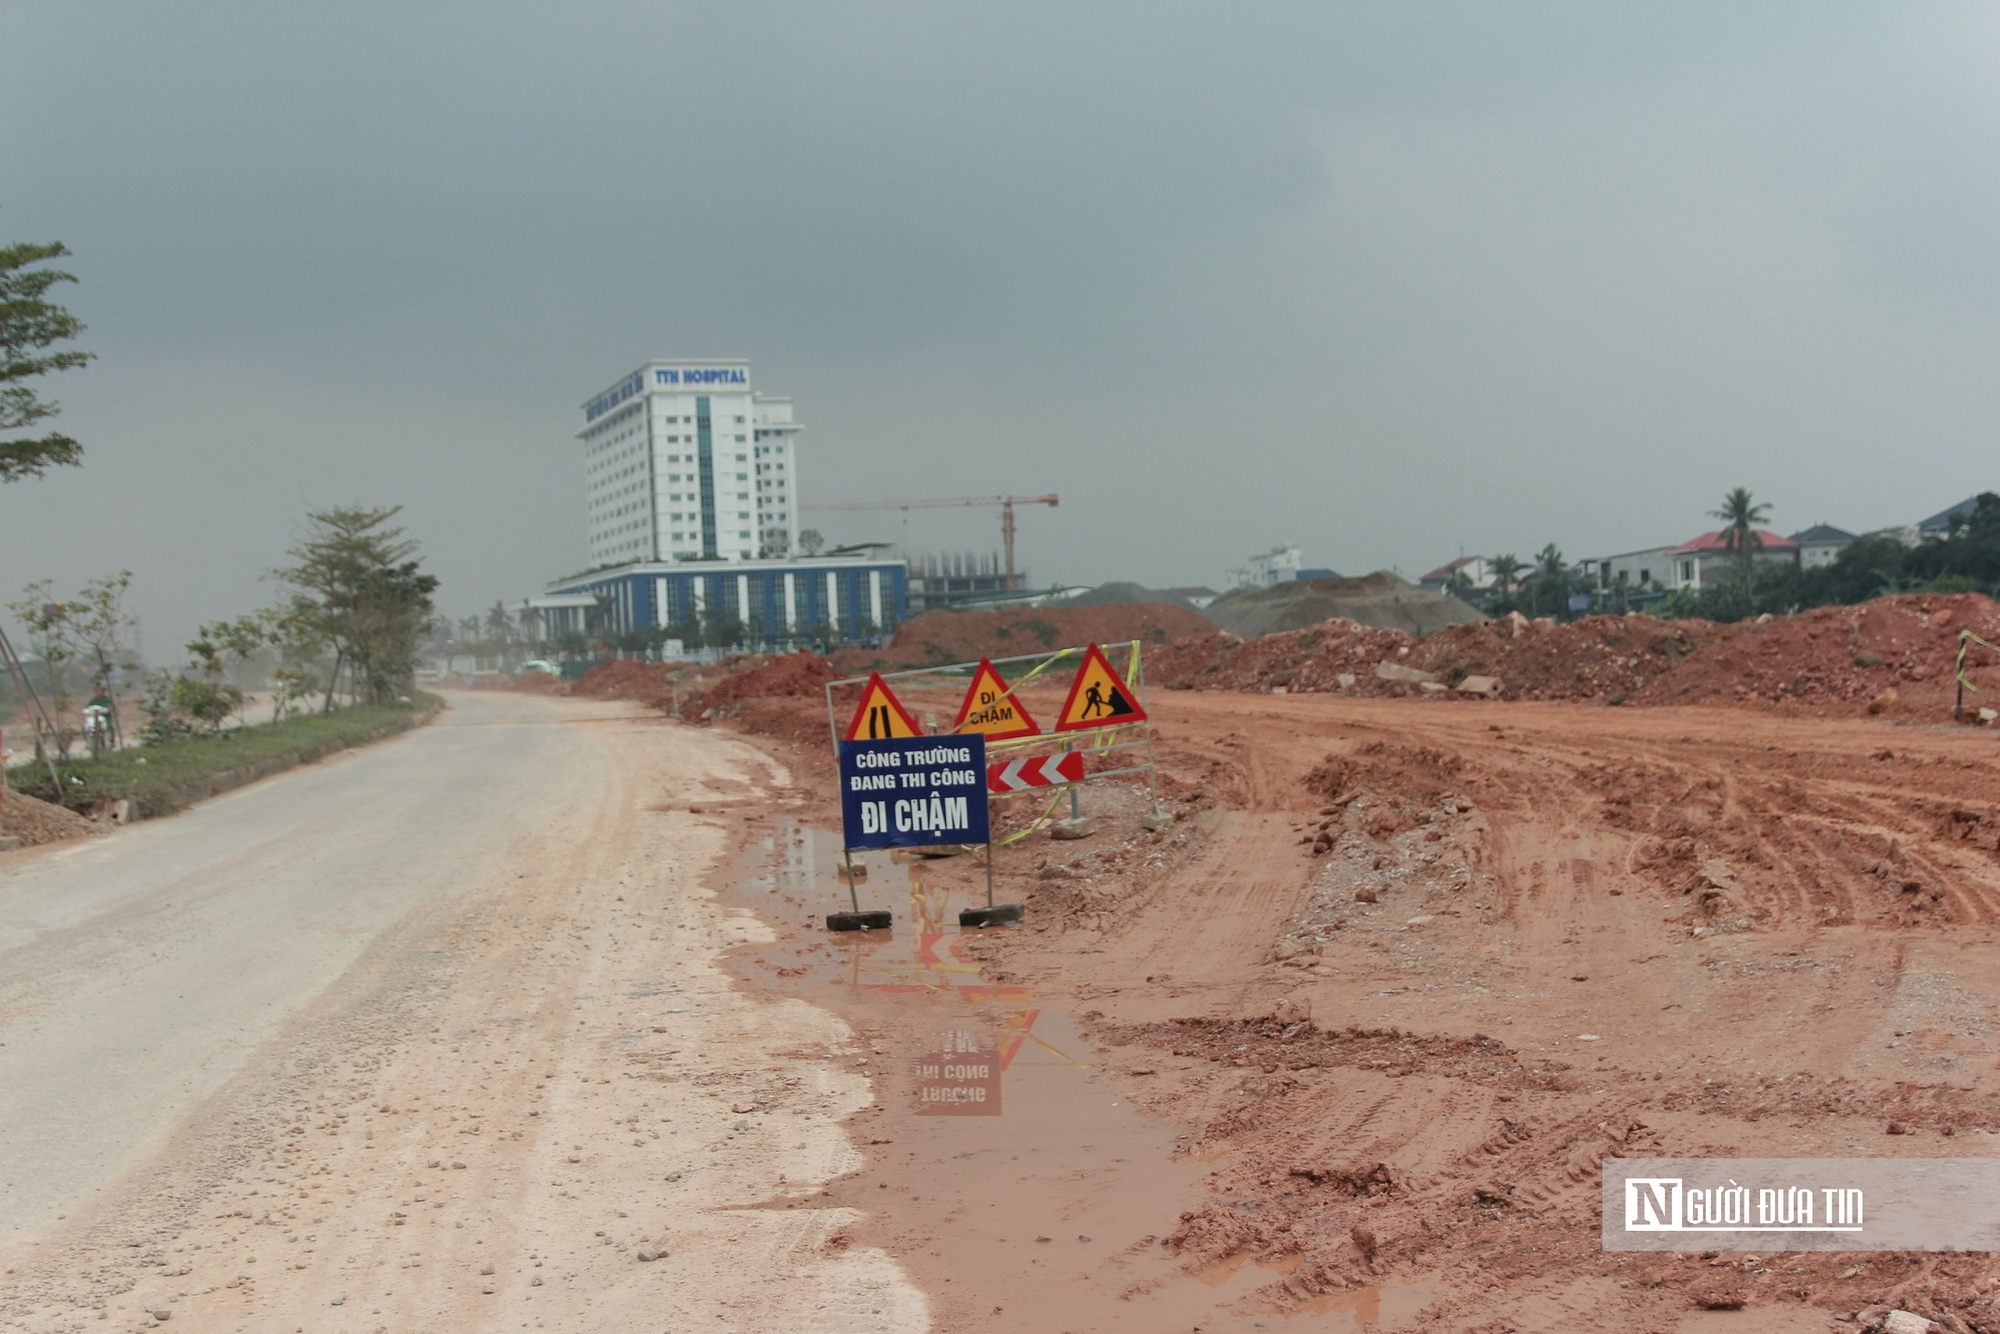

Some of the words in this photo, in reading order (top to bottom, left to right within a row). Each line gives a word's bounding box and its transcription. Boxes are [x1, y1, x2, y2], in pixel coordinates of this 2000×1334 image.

[655, 370, 679, 384] TTH
[683, 370, 747, 384] HOSPITAL
[981, 691, 995, 704] ĐI
[856, 750, 901, 768] CÔNG
[905, 746, 970, 766] TRƯỜNG
[851, 775, 896, 791] ĐANG
[900, 773, 926, 788] THI
[930, 768, 976, 786] CÔNG
[861, 801, 888, 834] ĐI
[894, 791, 969, 836] CHẬM
